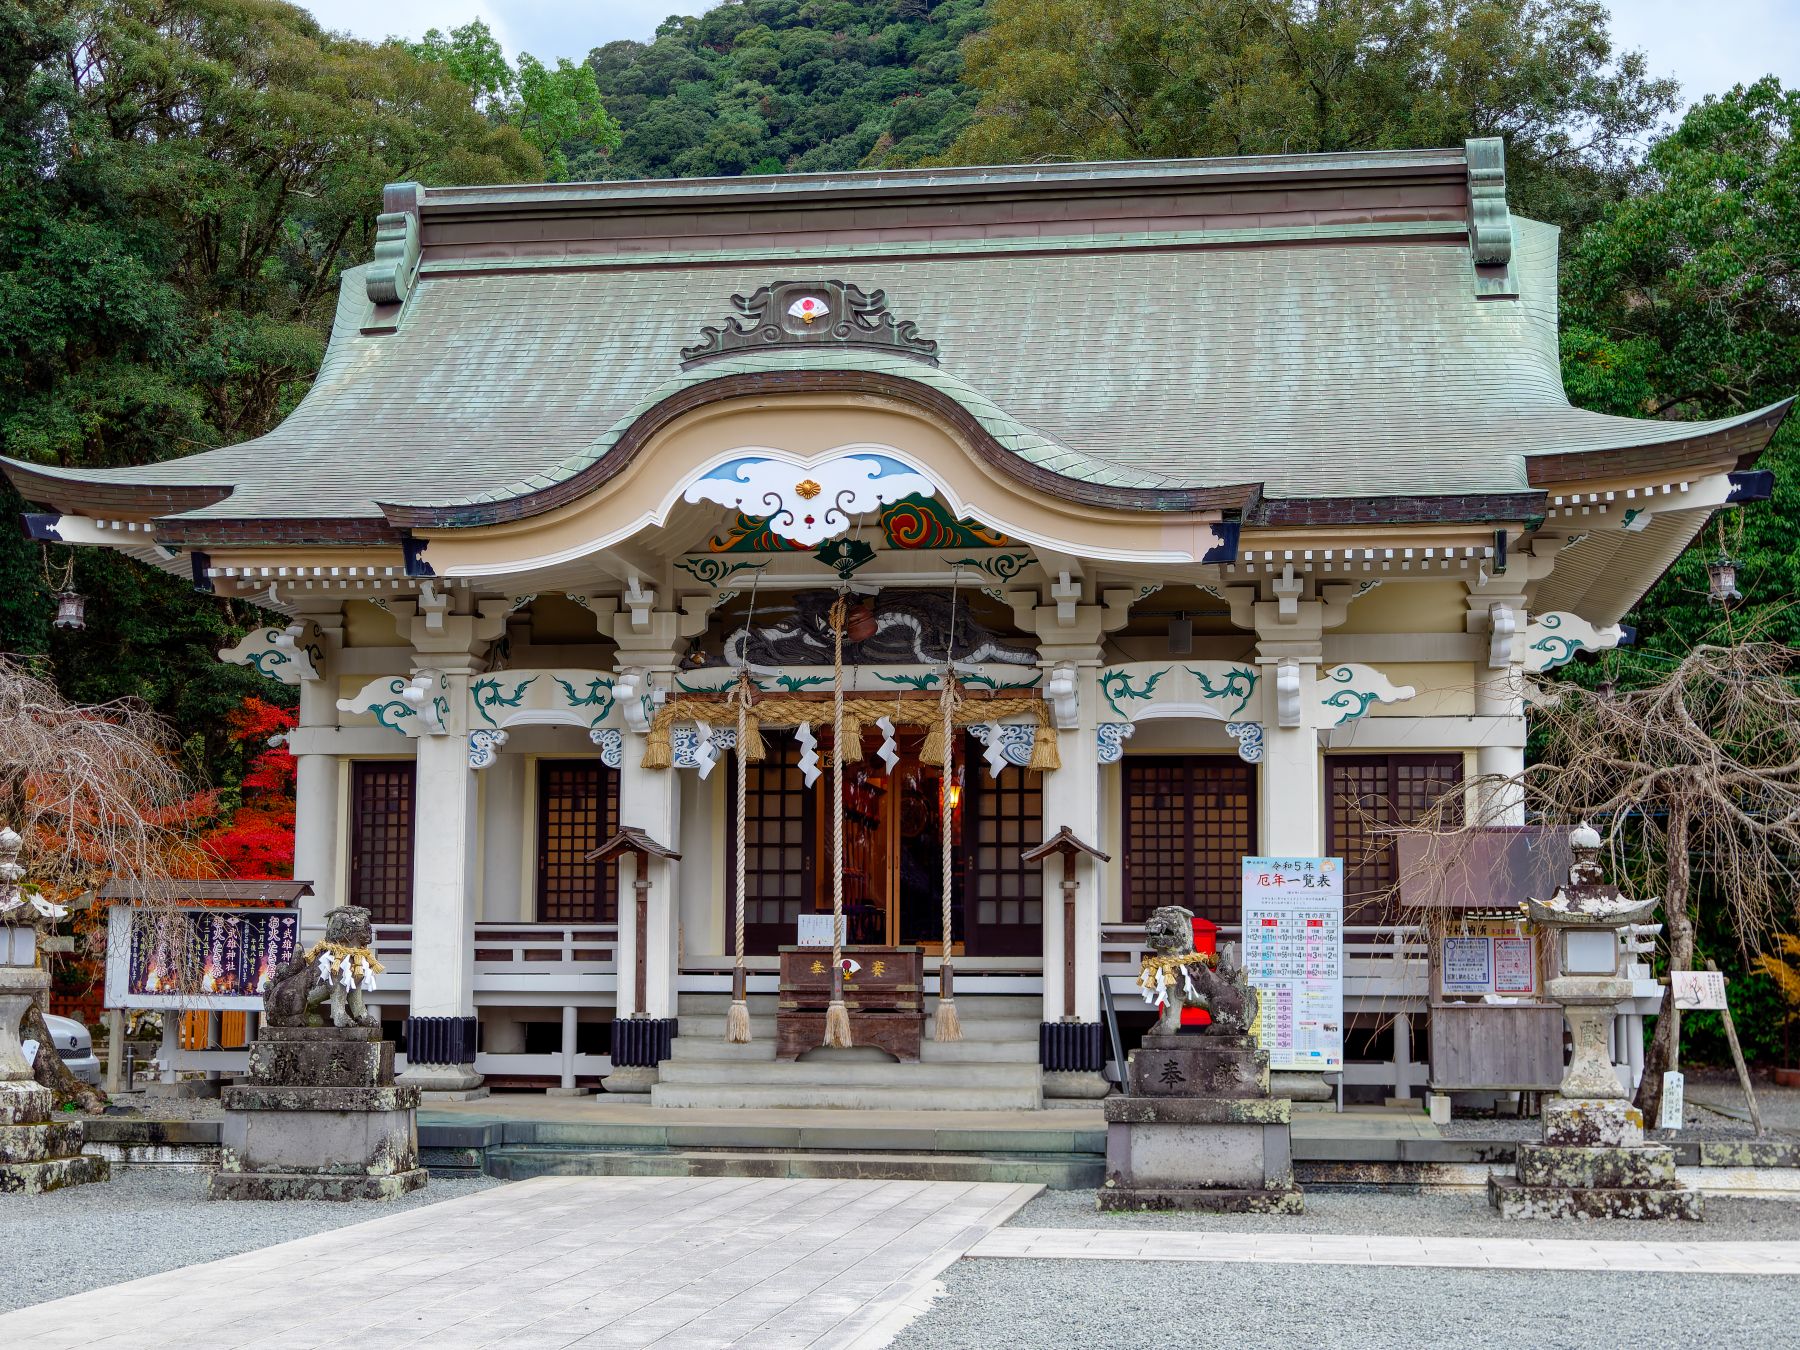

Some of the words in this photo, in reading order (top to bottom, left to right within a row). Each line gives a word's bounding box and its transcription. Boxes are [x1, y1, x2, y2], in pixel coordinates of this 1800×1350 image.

[1257, 873, 1331, 888] 厄年一覧表
[1272, 861, 1314, 871] 令和5年
[203, 919, 211, 956] 十二月五日
[212, 915, 226, 979] お火たき祭
[226, 928, 239, 972] 武雄神社
[258, 919, 267, 957] 十二月五日
[267, 915, 281, 979] お火たき祭
[282, 928, 294, 967] 武雄神
